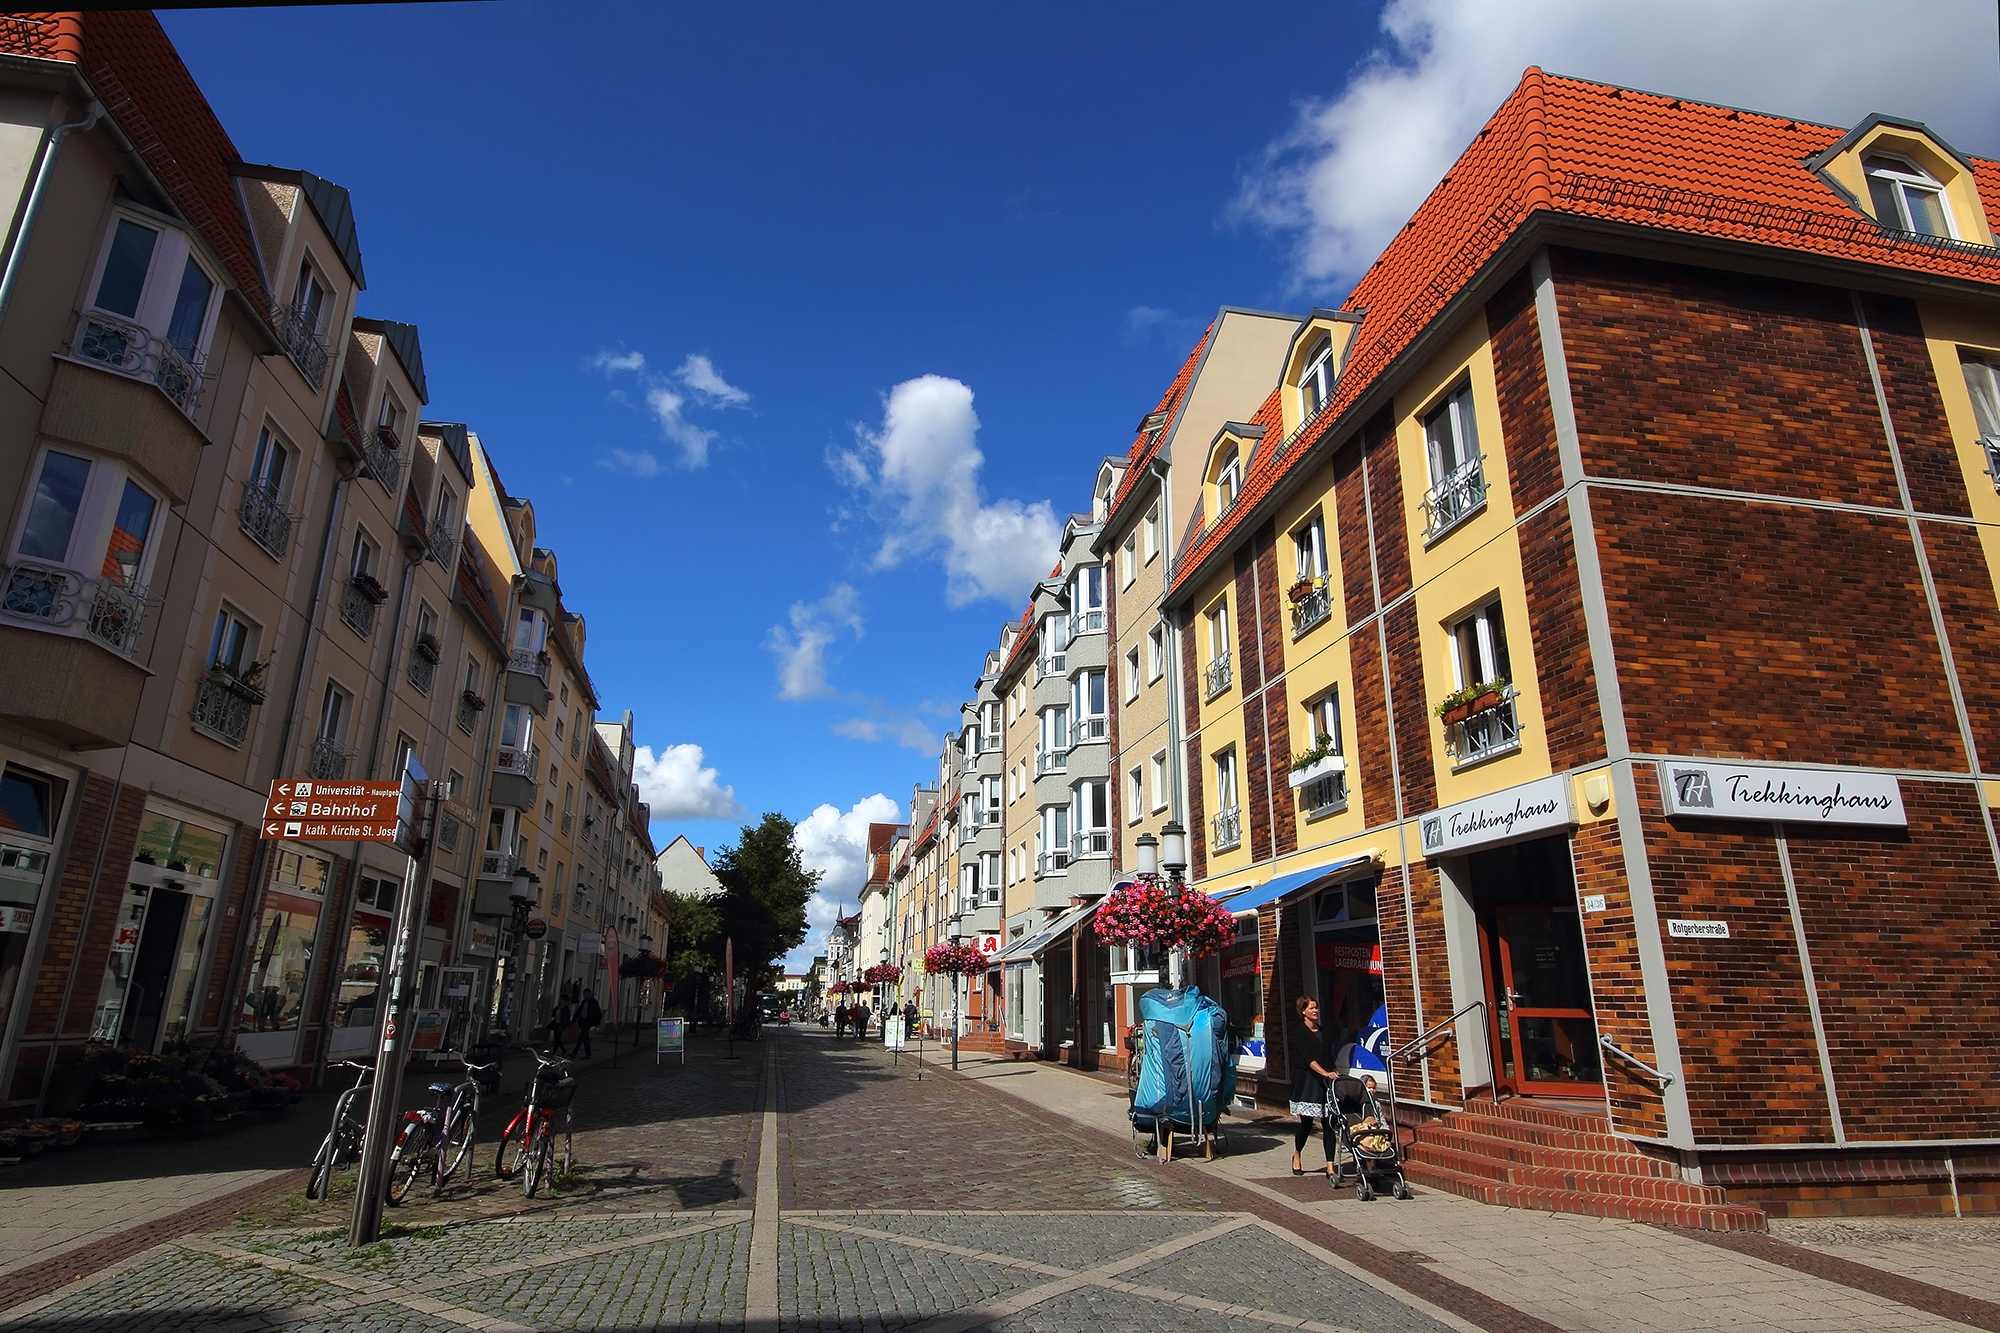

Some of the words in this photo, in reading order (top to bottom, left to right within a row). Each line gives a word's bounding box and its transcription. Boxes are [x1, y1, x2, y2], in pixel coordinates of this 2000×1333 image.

[315, 785, 365, 796] Universität
[1725, 774, 1893, 818] Trekkinghaus
[310, 803, 377, 817] Bahnhof
[1448, 797, 1559, 838] Trekkinghaus
[305, 825, 328, 836] kath.
[331, 825, 361, 836] Kirche
[362, 826, 374, 836] St.
[1672, 922, 1726, 936] Rotgerberstraße
[1335, 946, 1371, 958] RESTPOSTEN
[1231, 954, 1254, 967] RESTPOSTEN
